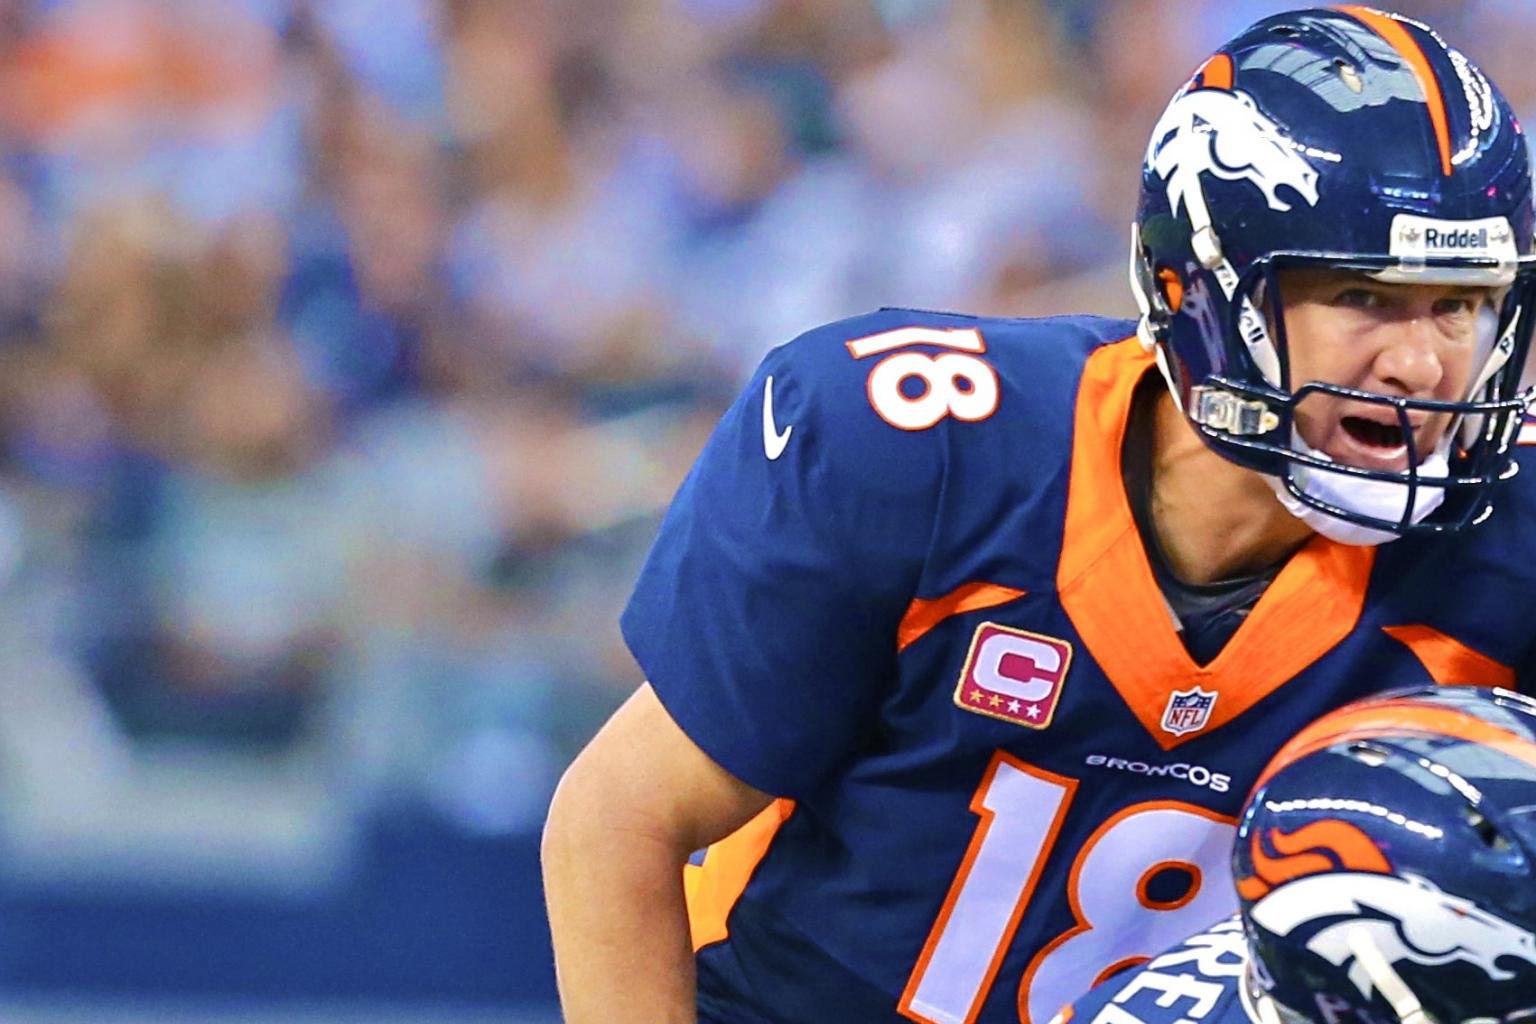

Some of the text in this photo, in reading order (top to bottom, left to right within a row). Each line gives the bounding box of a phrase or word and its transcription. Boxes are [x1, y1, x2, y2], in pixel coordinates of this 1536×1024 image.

[1426, 228, 1488, 248] Riddell
[844, 325, 1004, 432] 18
[972, 633, 1061, 702] C
[1170, 708, 1201, 727] NFL
[1085, 754, 1232, 793] BRONCOS
